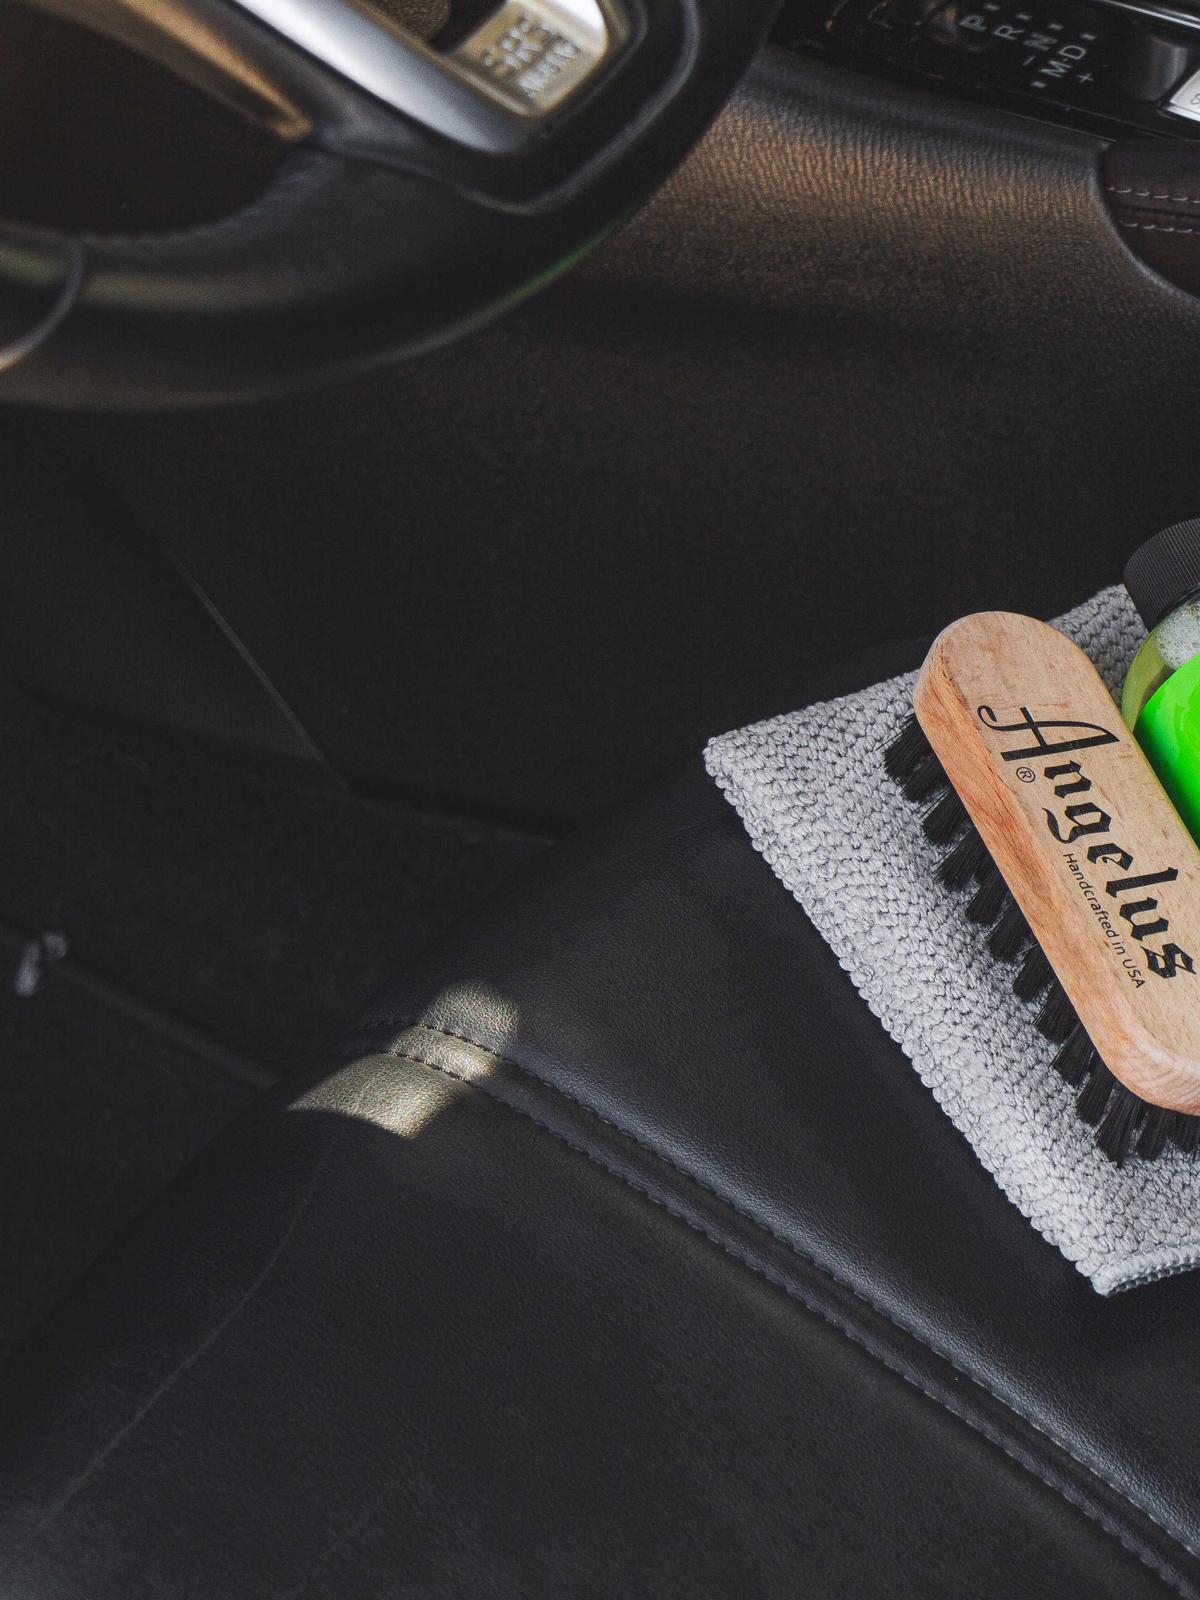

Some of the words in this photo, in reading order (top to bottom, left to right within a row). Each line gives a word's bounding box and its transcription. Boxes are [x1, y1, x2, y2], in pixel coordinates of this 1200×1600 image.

[960, 15, 987, 30] P
[994, 25, 1024, 40] R
[977, 705, 1197, 979] Angelus
[1063, 853, 1119, 941] Handcrafted
[1112, 940, 1126, 954] in
[1122, 957, 1146, 988] USA
